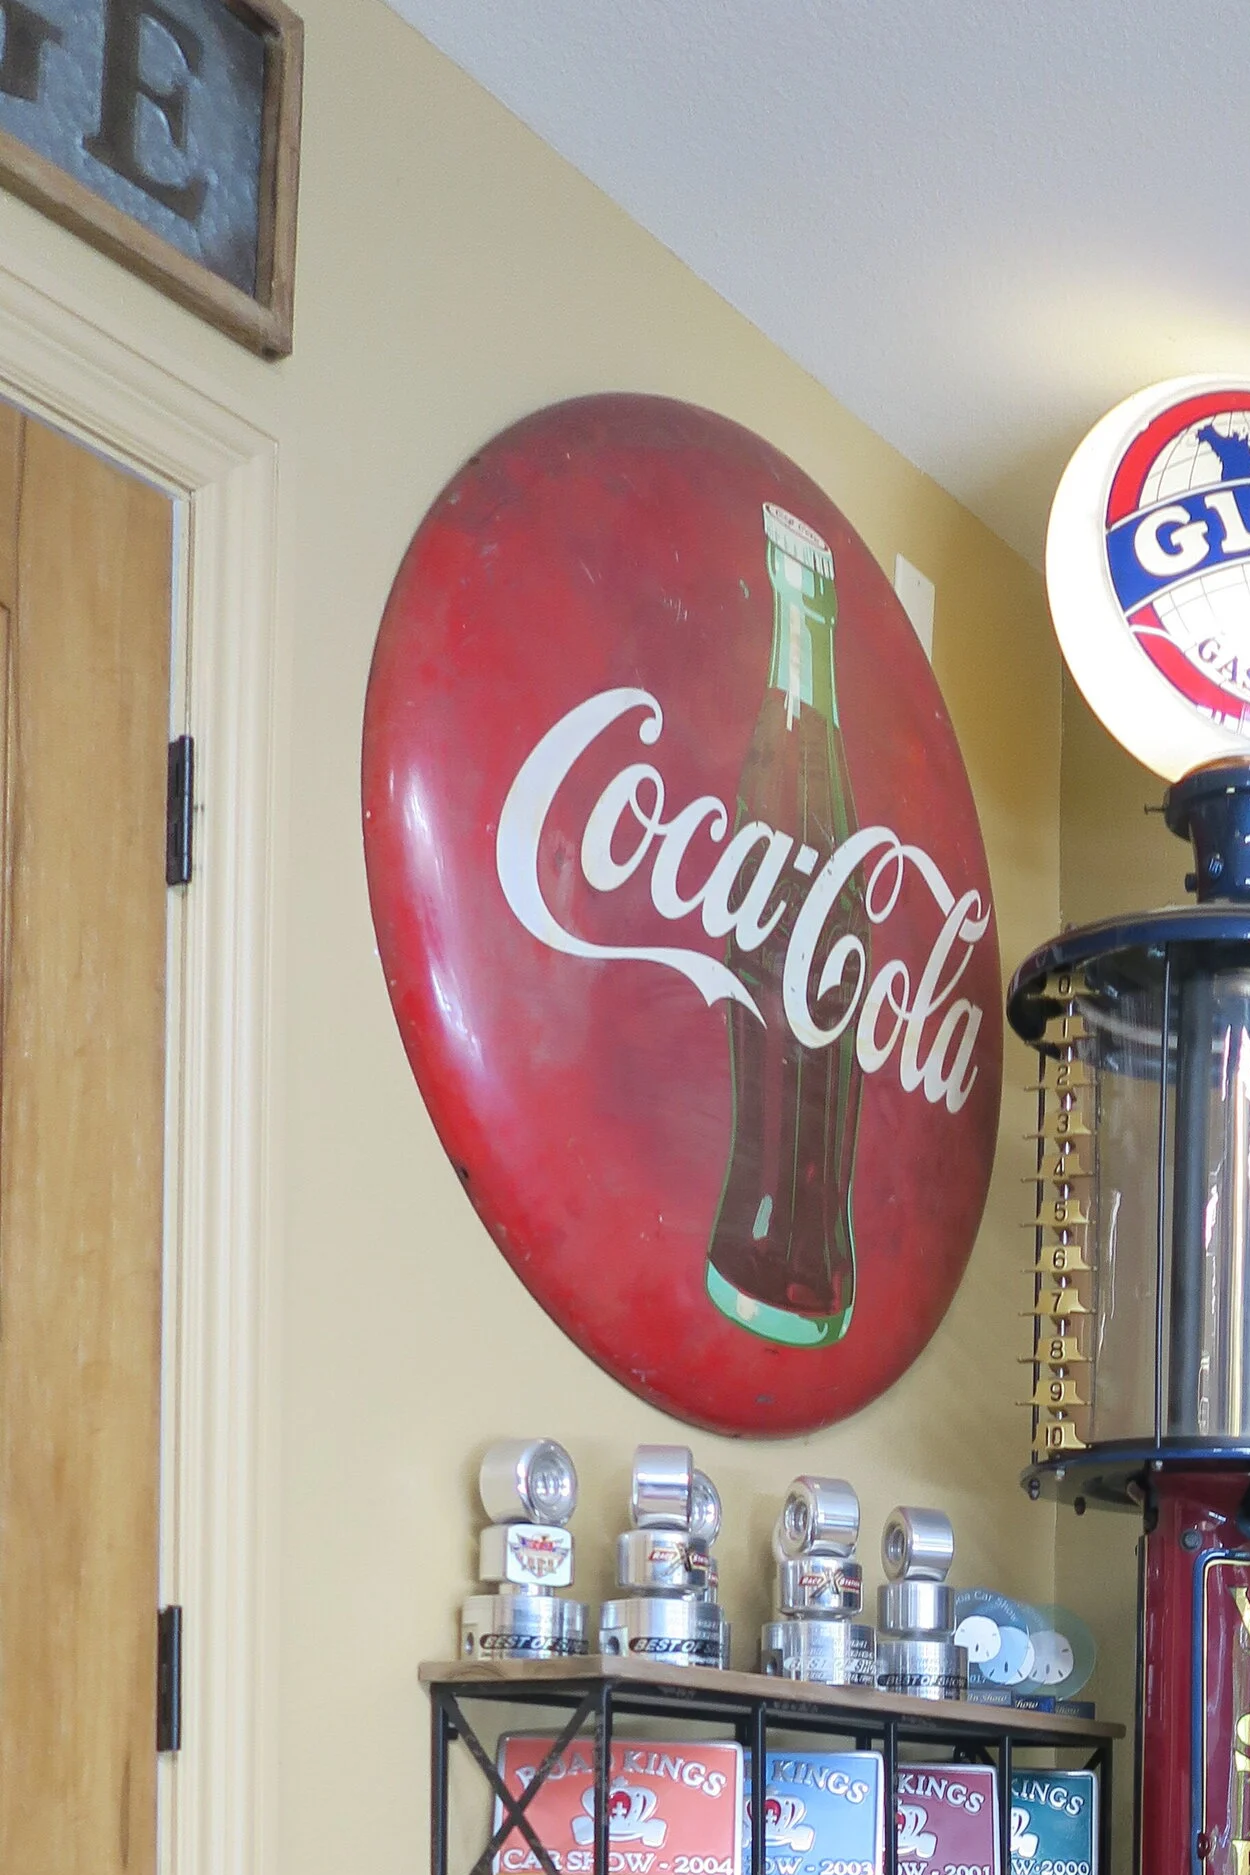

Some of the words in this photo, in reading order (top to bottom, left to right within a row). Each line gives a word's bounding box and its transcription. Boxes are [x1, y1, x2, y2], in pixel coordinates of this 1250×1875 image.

[1058, 975, 1071, 995] 0
[1056, 1064, 1070, 1086] 2
[1056, 1113, 1070, 1134] 3
[1053, 1157, 1066, 1178] 4
[1054, 1201, 1067, 1222] 5
[1052, 1248, 1066, 1269] 6
[1051, 1292, 1064, 1312] 7
[1050, 1339, 1065, 1360] 8
[1050, 1381, 1065, 1402] 9
[1044, 1426, 1064, 1447] 10
[484, 1635, 530, 1650] BEST
[635, 1638, 682, 1653] BEST
[1015, 1699, 1040, 1709] how
[623, 1749, 728, 1798] KINGS
[772, 1758, 869, 1804] KINGS
[899, 1773, 985, 1814] KINGS
[503, 1850, 563, 1871] CAR
[674, 1856, 734, 1875] 2004
